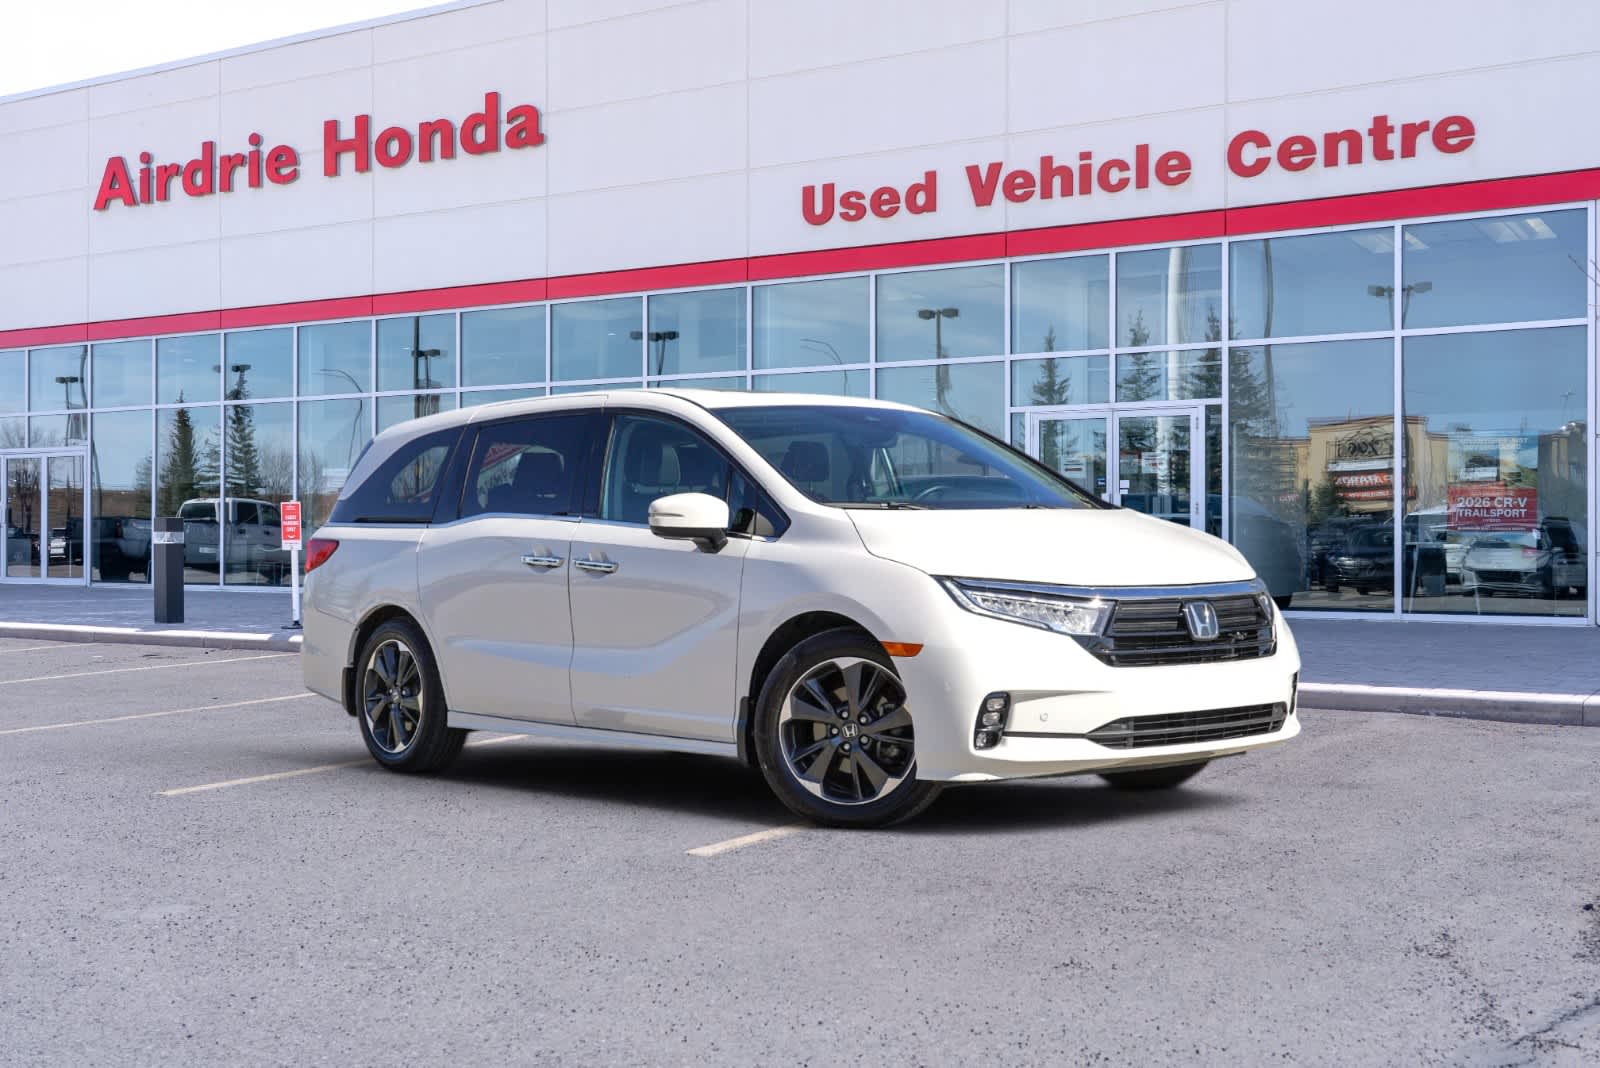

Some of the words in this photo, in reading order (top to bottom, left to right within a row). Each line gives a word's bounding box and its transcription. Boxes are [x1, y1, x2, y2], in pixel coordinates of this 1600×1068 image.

[94, 134, 299, 211] Airdrie
[323, 91, 546, 177] Honda
[801, 171, 937, 226] Used
[965, 143, 1193, 208] Vehicle
[1227, 115, 1476, 178] Centre
[1456, 496, 1491, 508] 2026
[1494, 496, 1528, 508] CR-V
[1457, 508, 1528, 518] TRAILSPORT
